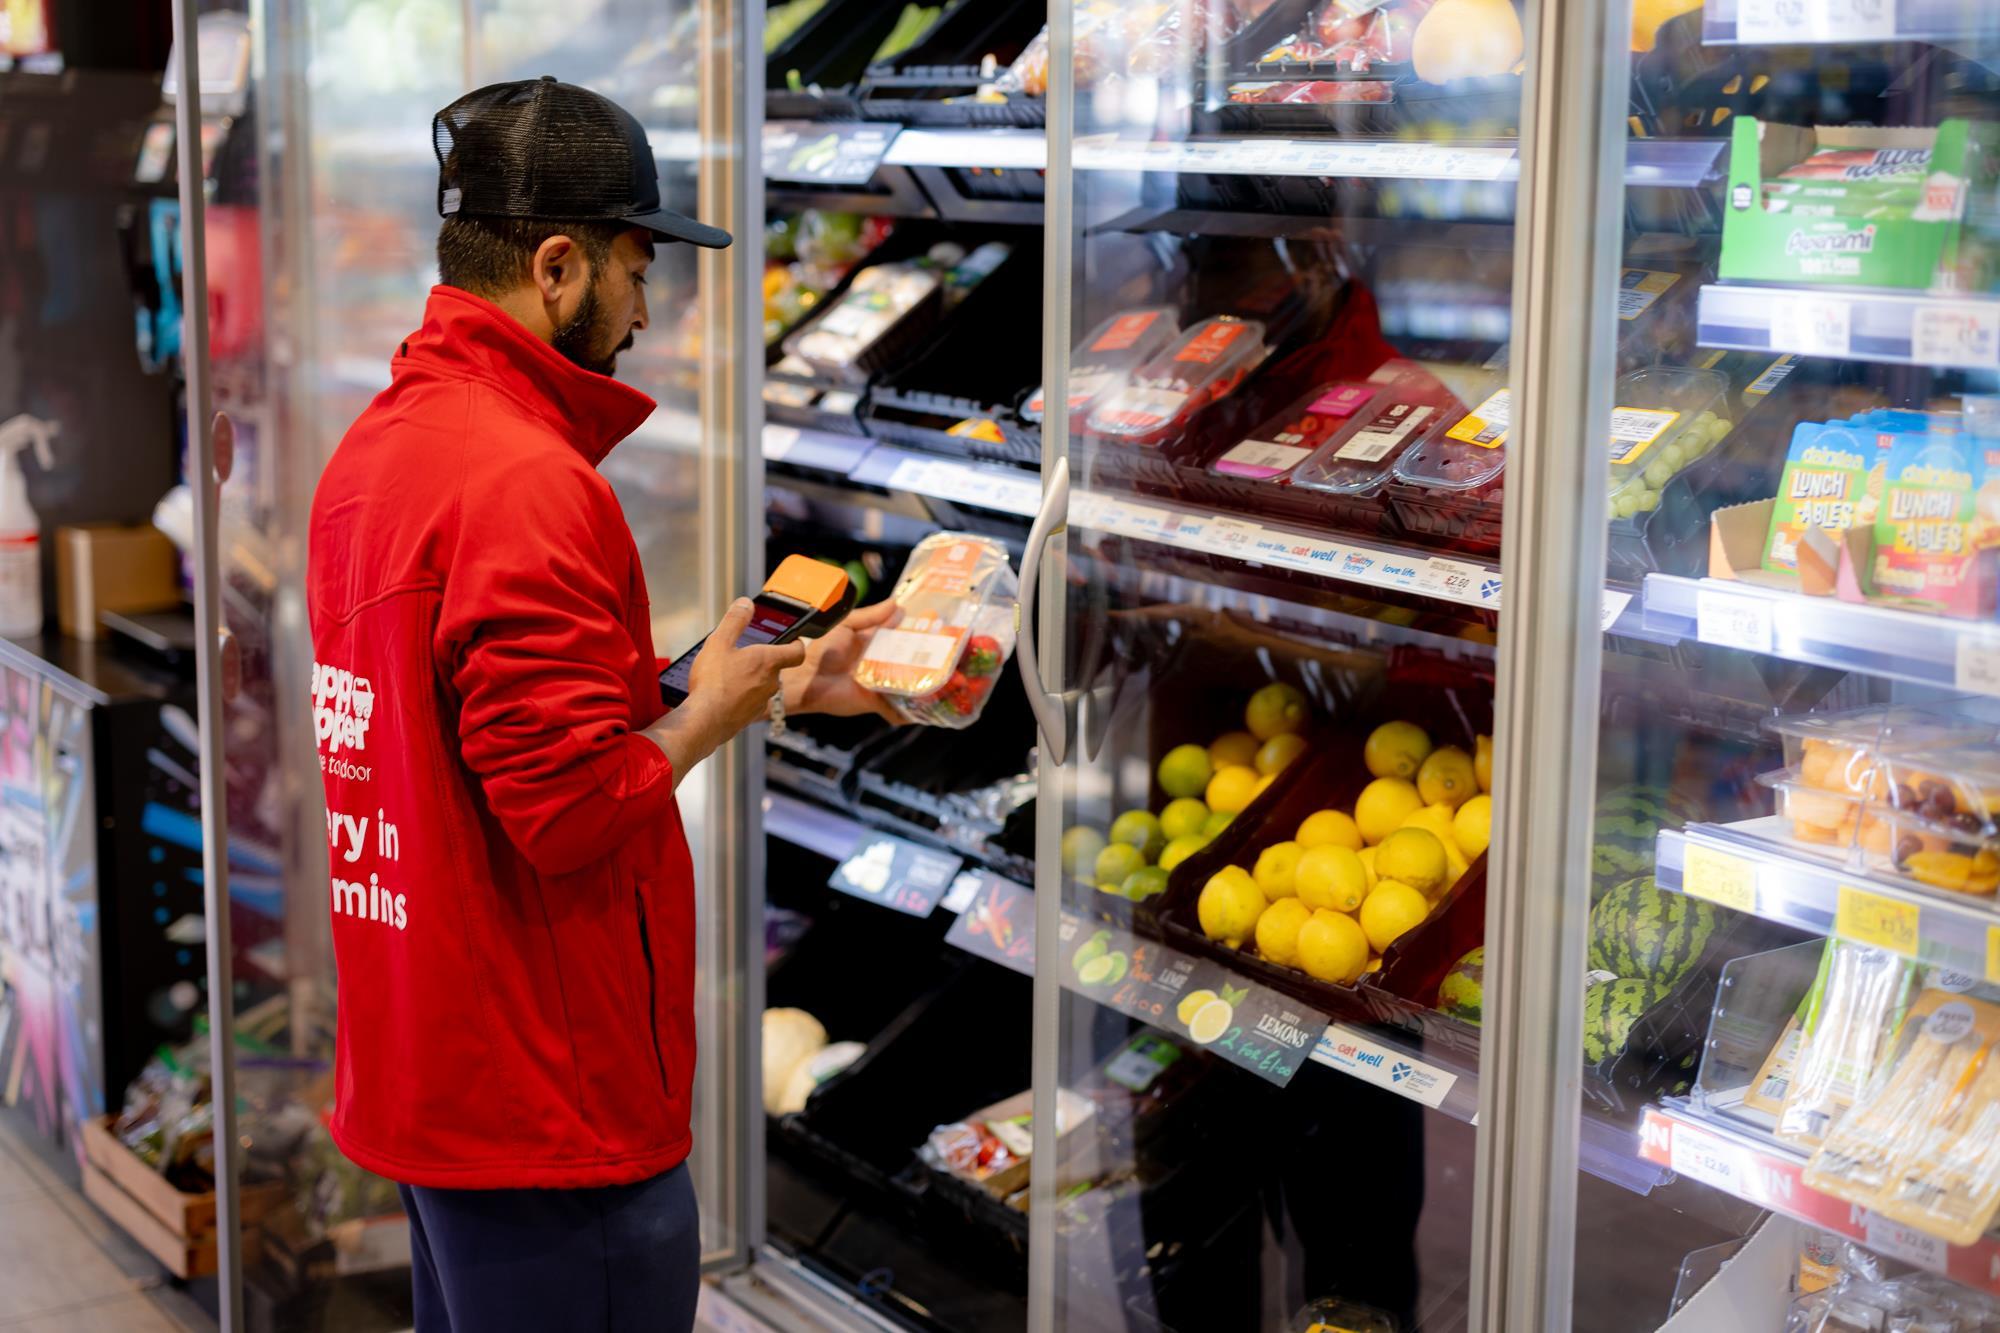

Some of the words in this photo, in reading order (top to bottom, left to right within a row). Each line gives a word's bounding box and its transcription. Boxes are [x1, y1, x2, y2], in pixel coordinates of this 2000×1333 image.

[1791, 470, 1848, 499] LUNCH
[1890, 490, 1953, 521] LUNCH
[1310, 549, 1338, 562] well
[1382, 564, 1401, 575] love
[1401, 566, 1416, 577] life
[378, 807, 399, 862] in
[332, 872, 408, 931] mins
[1220, 1027, 1242, 1050] 2
[1256, 1013, 1310, 1048] LEMONS
[1357, 1050, 1385, 1068] well
